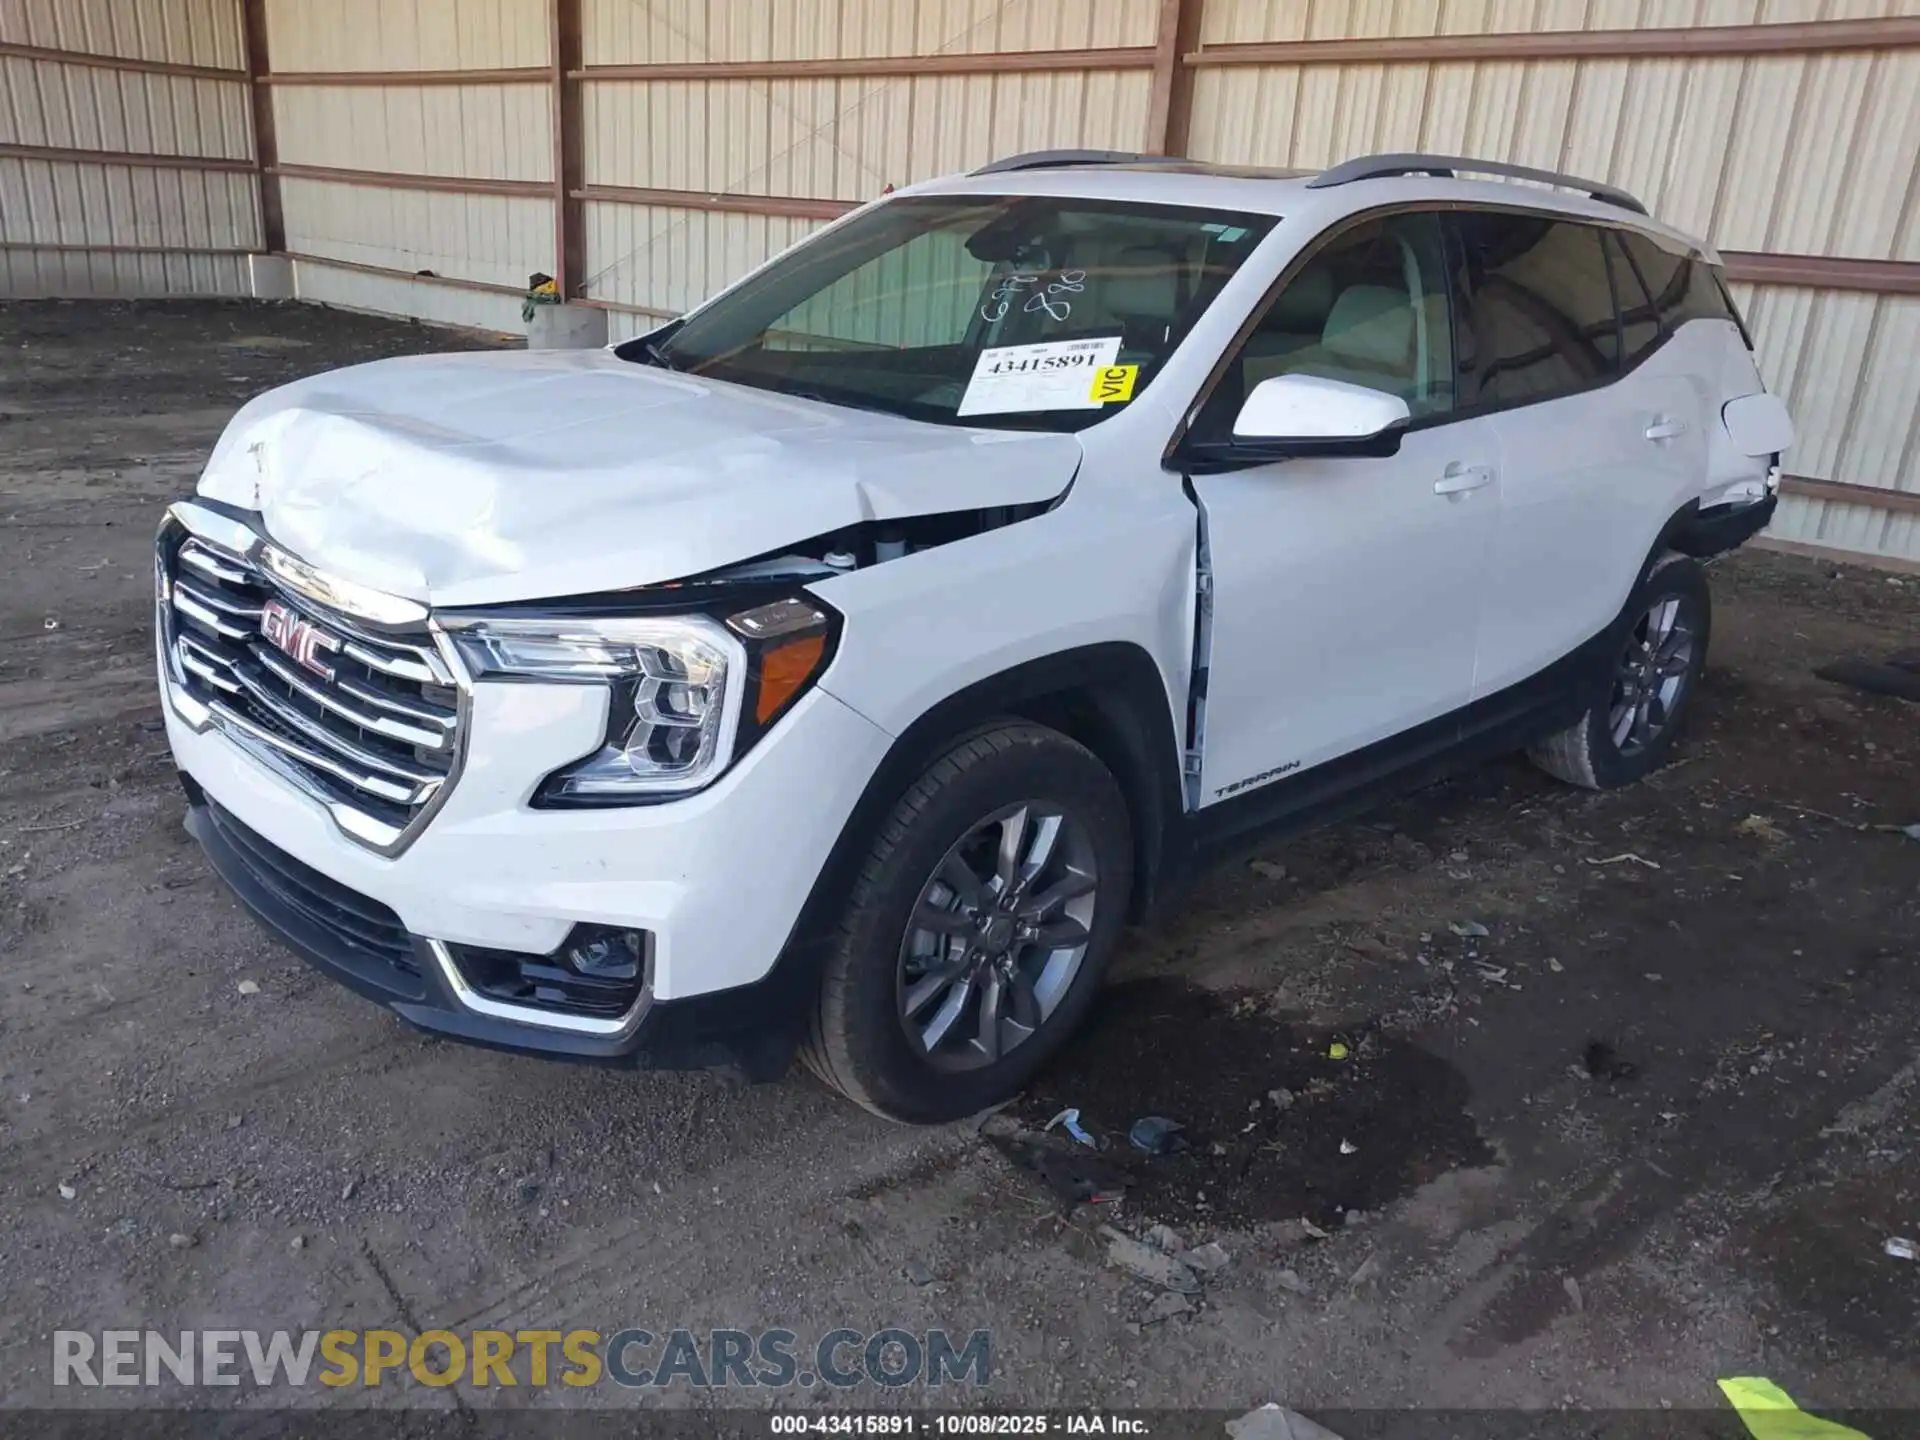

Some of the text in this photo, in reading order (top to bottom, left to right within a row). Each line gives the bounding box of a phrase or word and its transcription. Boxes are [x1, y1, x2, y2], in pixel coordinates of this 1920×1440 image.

[988, 352, 1096, 374] 43415891
[1098, 368, 1128, 398] VIC
[261, 599, 341, 684] GMC
[1214, 760, 1301, 797] TERRAIN
